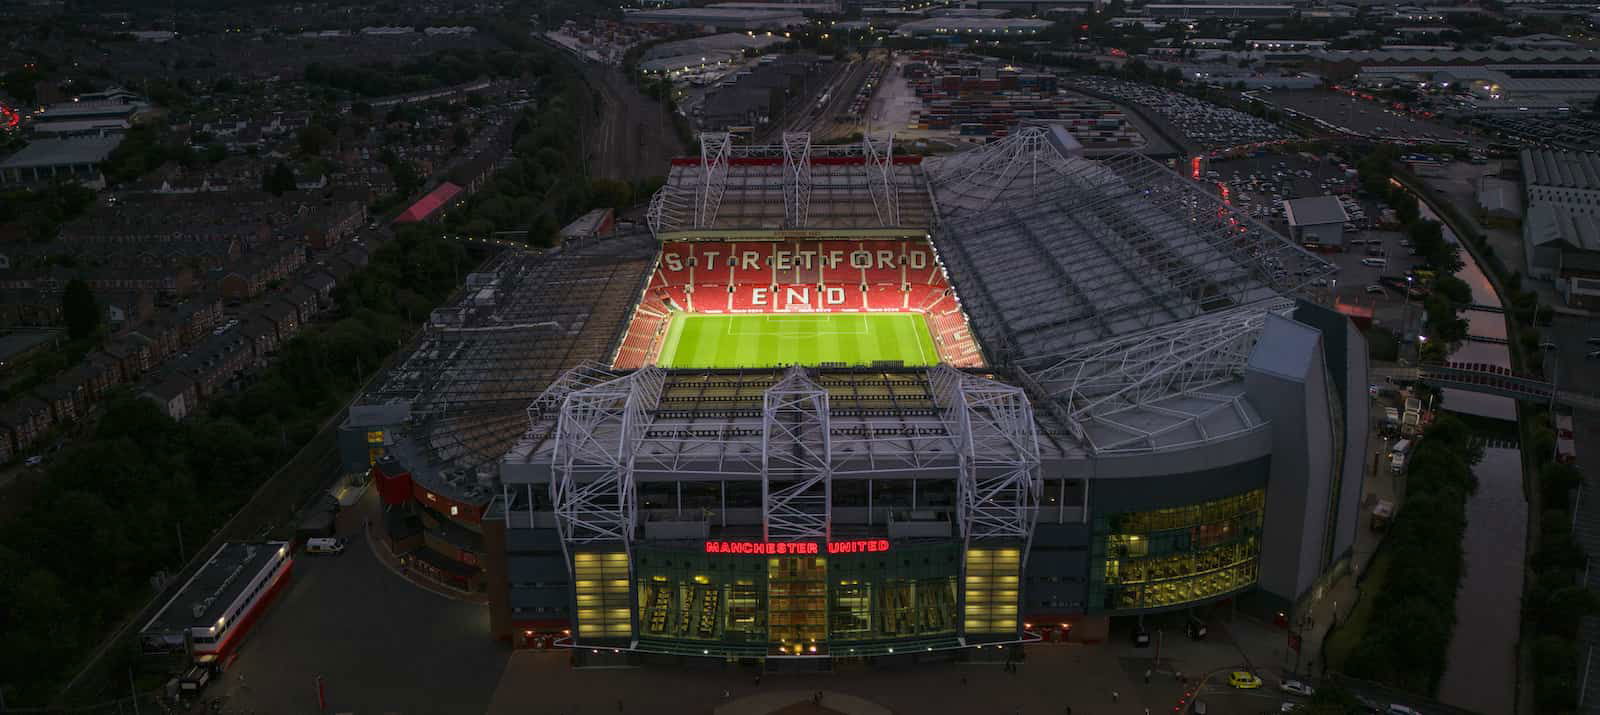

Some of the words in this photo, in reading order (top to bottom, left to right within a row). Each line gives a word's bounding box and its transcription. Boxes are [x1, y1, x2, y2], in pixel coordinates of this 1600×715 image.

[665, 251, 928, 272] STRETFORD
[752, 287, 846, 305] END
[705, 541, 818, 554] MANCHESTER
[828, 540, 889, 553] UNITED
